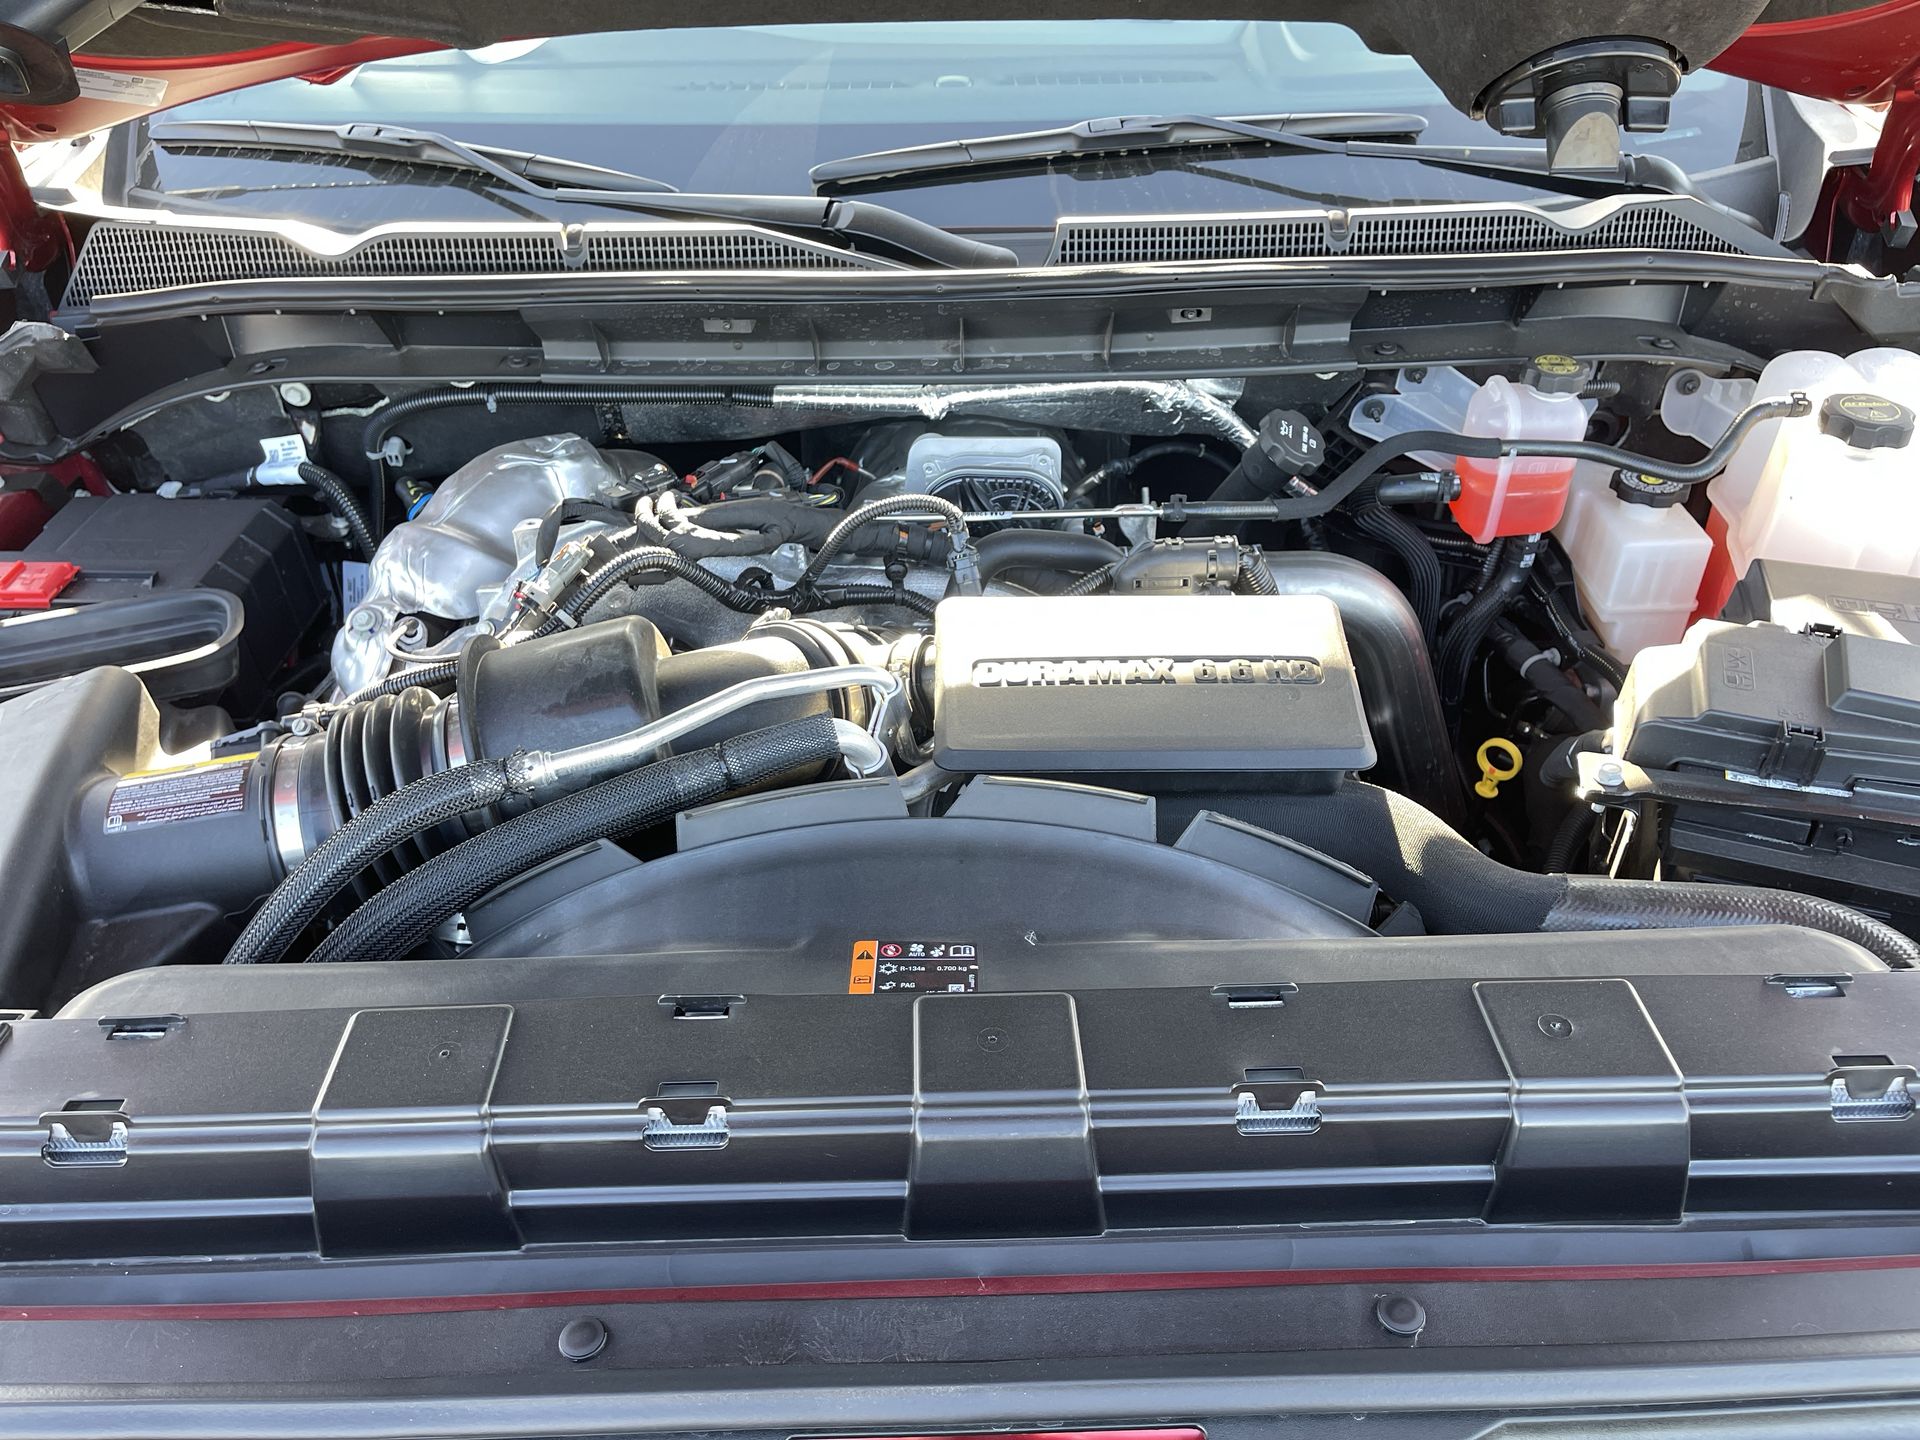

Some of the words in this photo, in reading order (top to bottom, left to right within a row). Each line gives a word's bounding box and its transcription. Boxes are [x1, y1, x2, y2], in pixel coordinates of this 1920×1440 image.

[975, 658, 1177, 685] DURAMAX
[1193, 659, 1255, 684] 6.6
[1263, 659, 1321, 684] HD
[958, 965, 968, 973] kg
